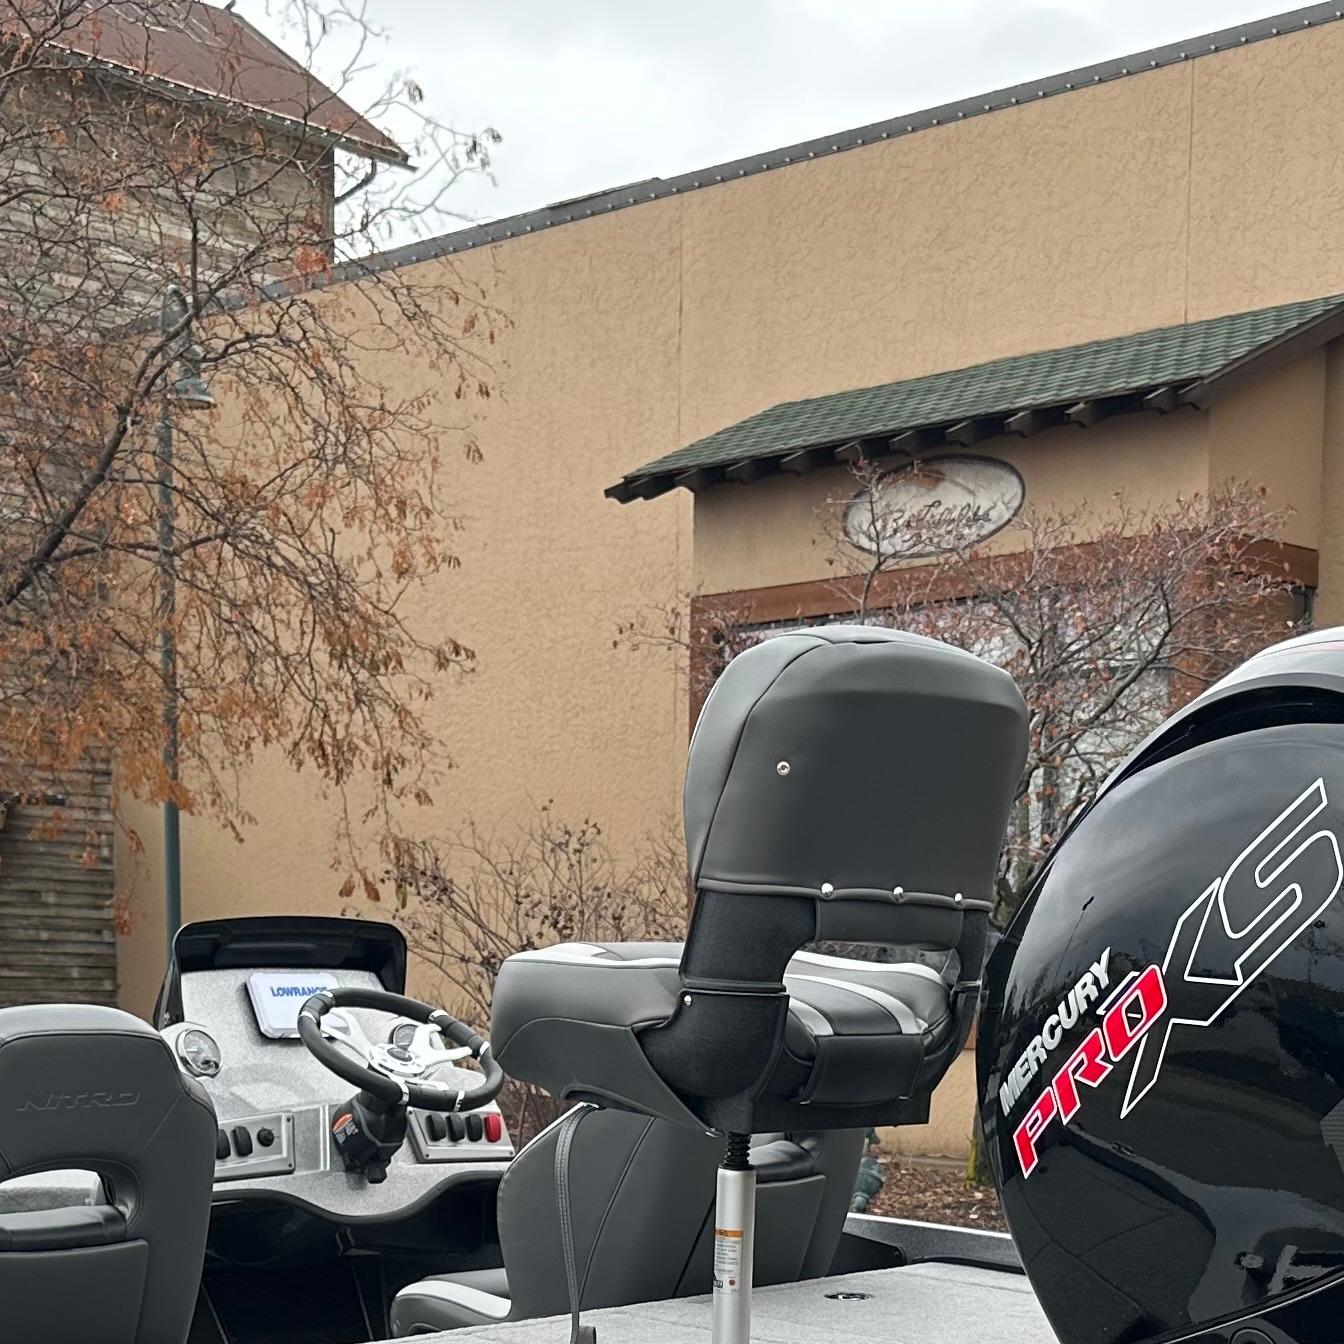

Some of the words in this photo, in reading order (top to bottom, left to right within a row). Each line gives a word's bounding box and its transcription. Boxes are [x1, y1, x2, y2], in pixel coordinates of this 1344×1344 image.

[998, 946, 1114, 1117] MERCURY
[1012, 963, 1168, 1179] PRO
[1097, 777, 1344, 1120] XS
[17, 1087, 142, 1112] NITRO
